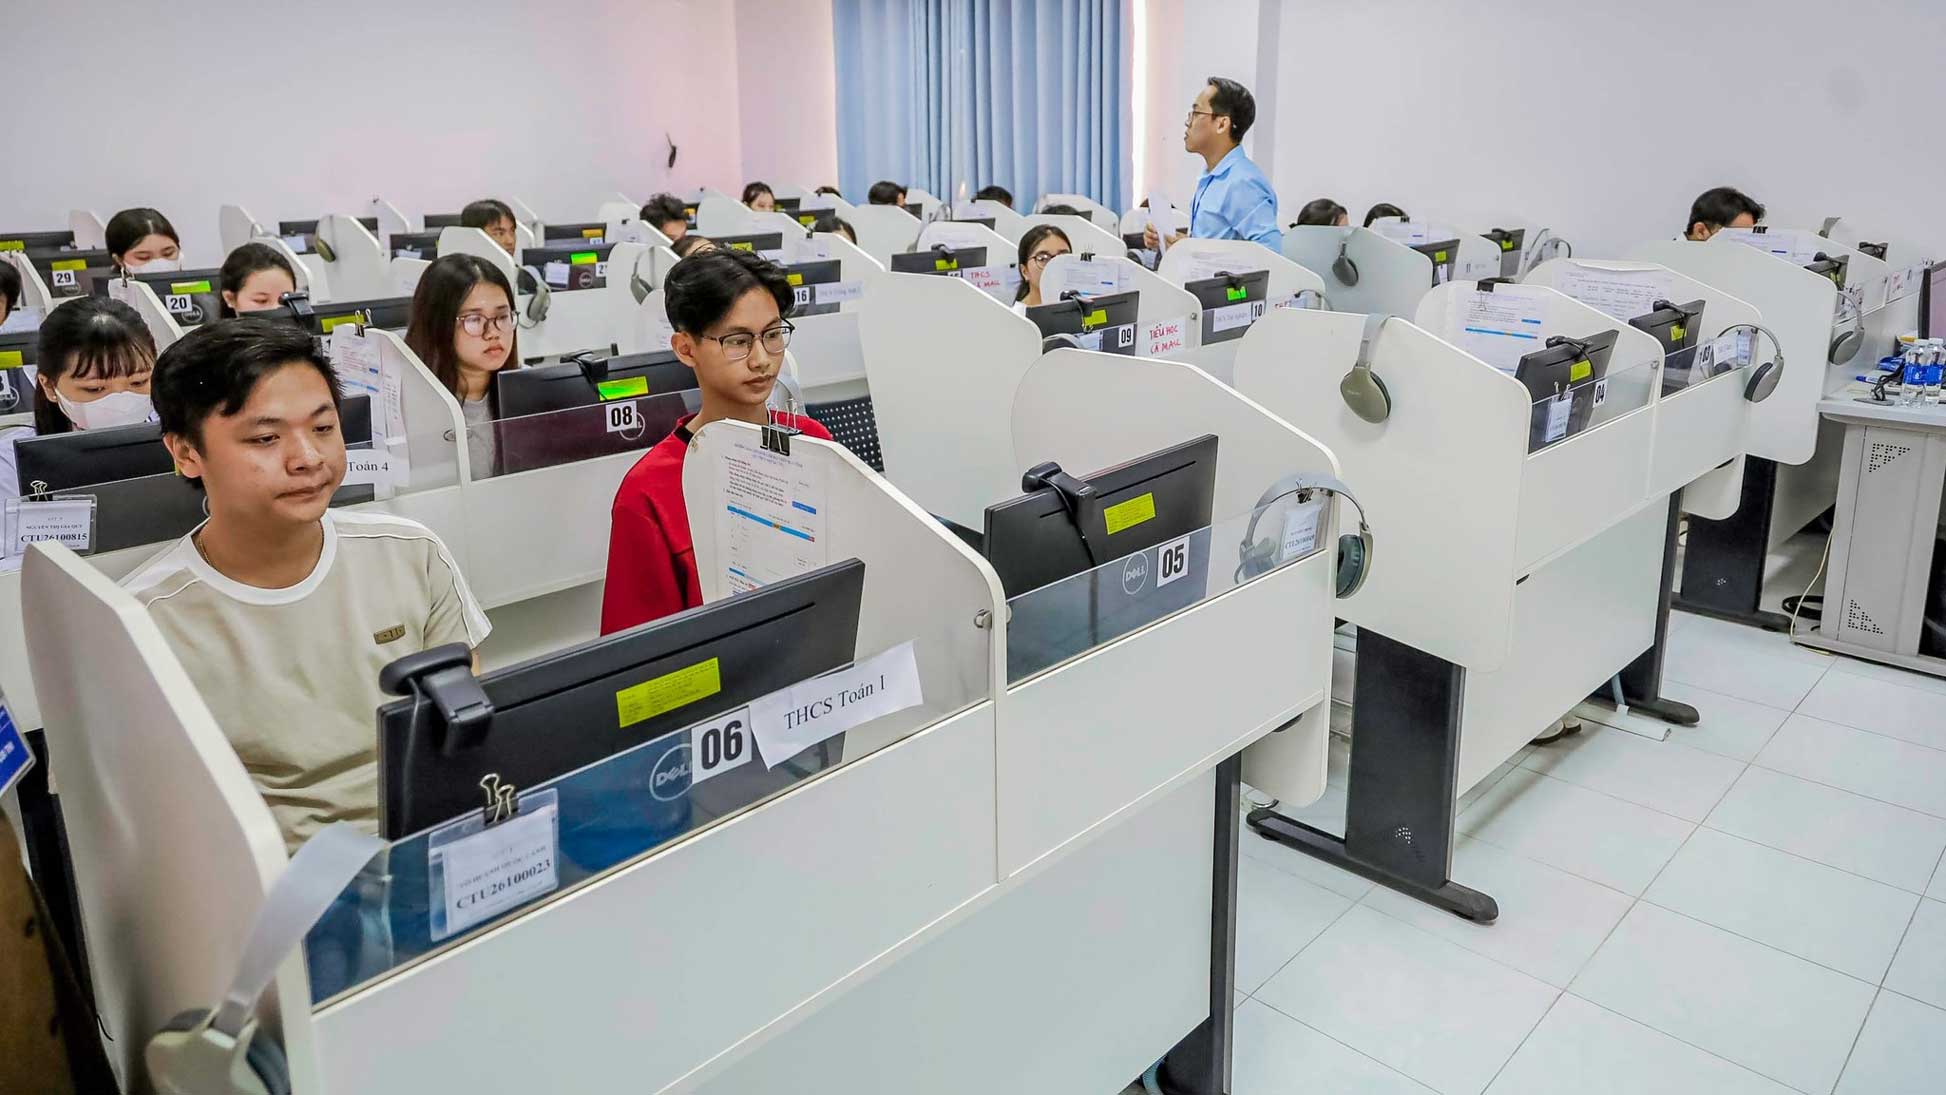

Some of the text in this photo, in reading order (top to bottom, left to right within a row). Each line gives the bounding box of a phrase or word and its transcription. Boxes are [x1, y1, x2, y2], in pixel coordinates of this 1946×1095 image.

[56, 272, 71, 284] 29
[170, 297, 187, 310] 20
[796, 290, 807, 302] 16
[1254, 303, 1263, 317] 10
[1121, 328, 1132, 344] 09
[1595, 384, 1605, 403] 04
[611, 405, 633, 427] 08
[381, 462, 389, 472] 4
[1162, 543, 1184, 578] 05
[1125, 565, 1145, 582] DELL
[783, 697, 833, 730] THCS
[838, 681, 874, 708] Toán
[701, 720, 743, 770] 06
[456, 858, 550, 909] CTU26100023
